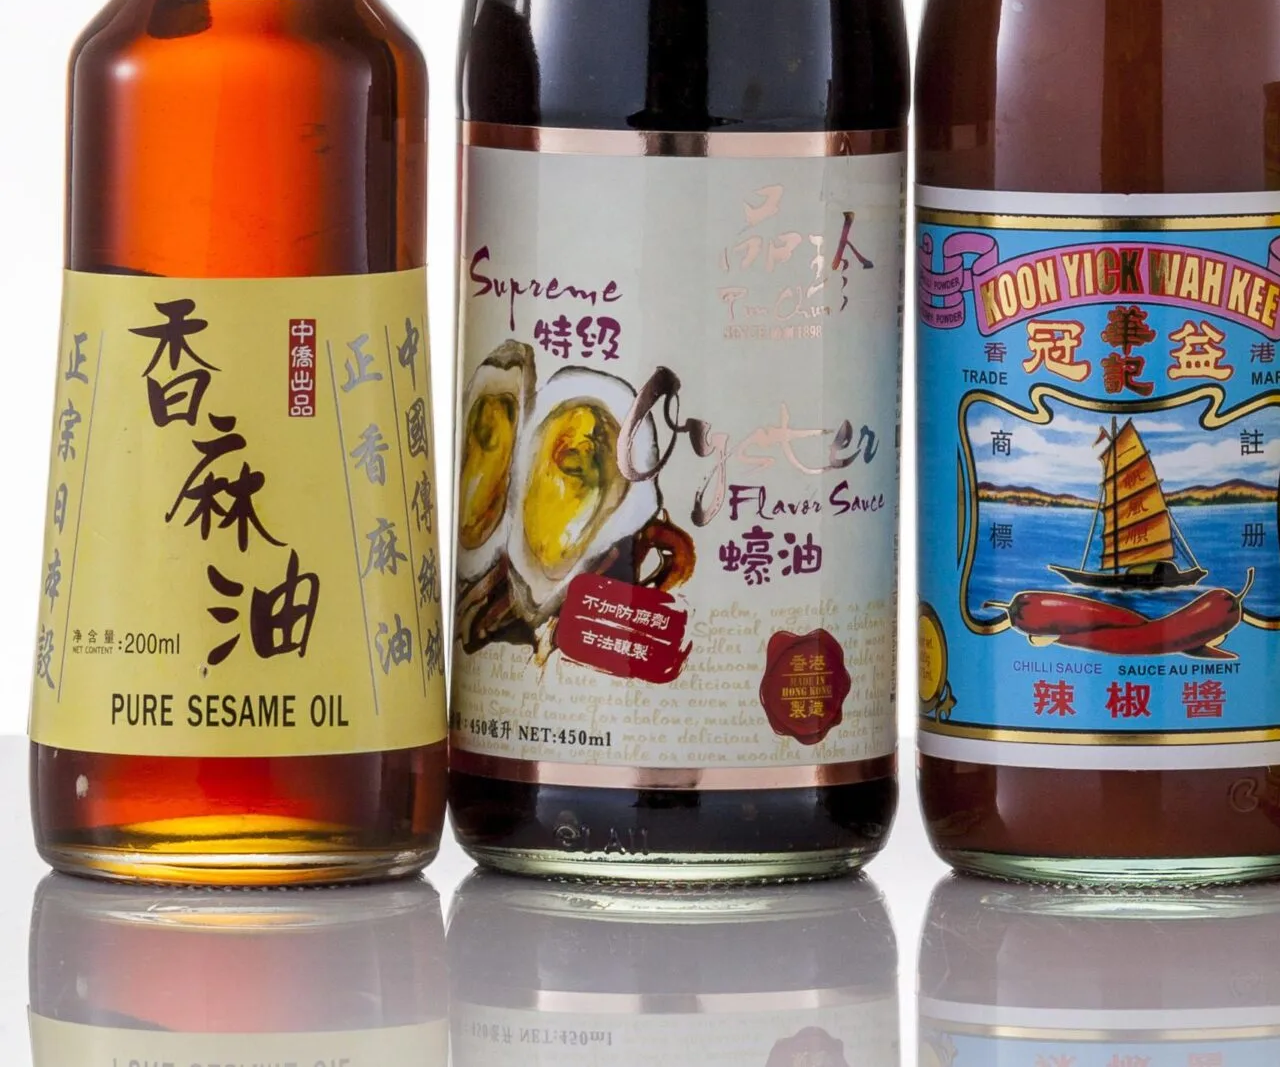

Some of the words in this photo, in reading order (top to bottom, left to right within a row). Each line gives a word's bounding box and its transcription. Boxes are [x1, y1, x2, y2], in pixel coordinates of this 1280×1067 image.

[469, 245, 623, 332] Supreme
[980, 255, 1061, 327] KOON
[1060, 246, 1145, 299] YICK
[1147, 250, 1227, 305] WAH
[291, 320, 315, 417] 中僑出品
[962, 369, 1008, 386] TRADE
[128, 298, 320, 668] 香麻油
[729, 484, 823, 522] Flavor
[719, 526, 823, 587] 蠔油
[1013, 660, 1053, 674] CHILLI
[1055, 662, 1103, 675] SAUCE
[1117, 664, 1167, 677] SAUCE
[1169, 664, 1189, 677] AU
[1191, 662, 1241, 676] PIMENT
[111, 693, 173, 728] PURE
[187, 693, 296, 728] SESAME
[310, 693, 349, 728] OIL
[1033, 680, 1227, 719] 辣椒醬
[518, 725, 612, 747] NET:450ml
